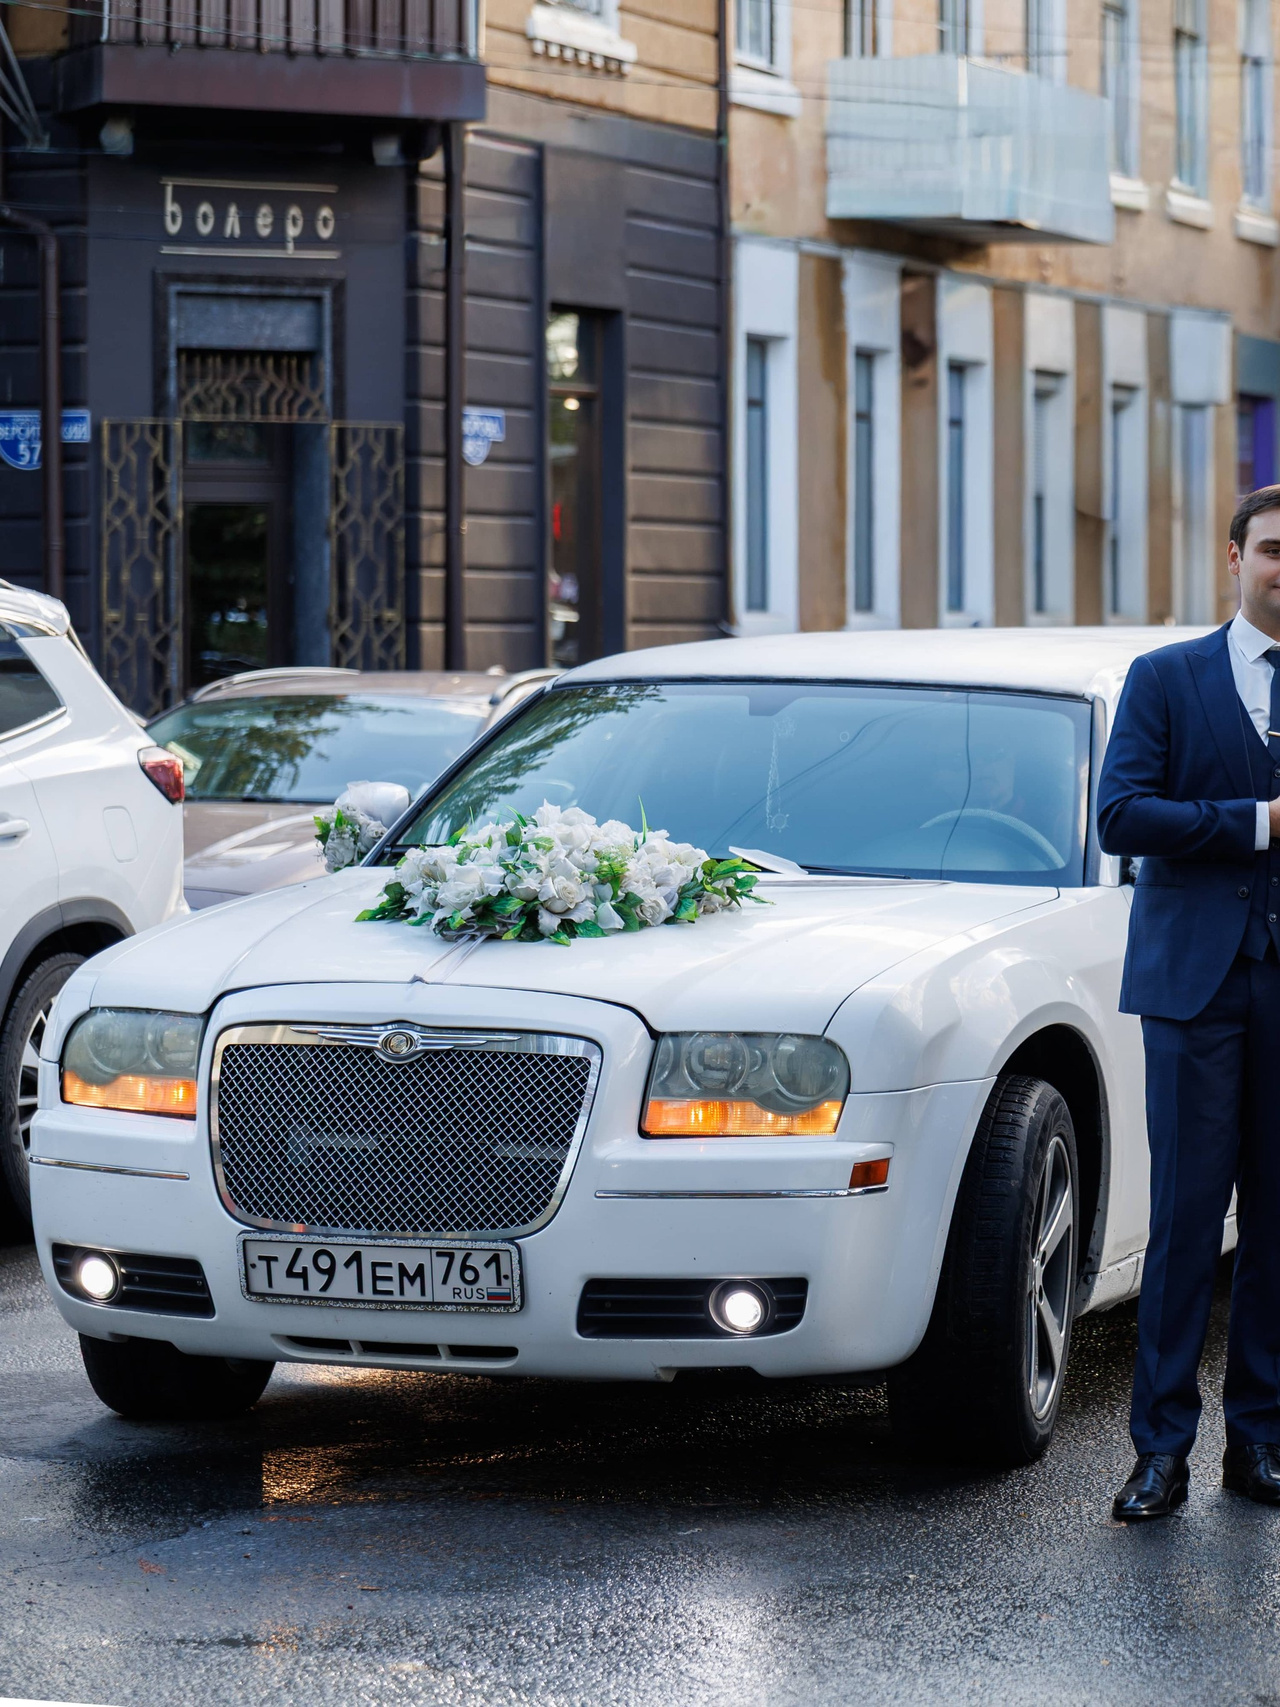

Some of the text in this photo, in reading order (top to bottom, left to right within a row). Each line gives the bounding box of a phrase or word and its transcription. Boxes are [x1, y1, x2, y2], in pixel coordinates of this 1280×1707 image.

[19, 444, 41, 465] 57
[435, 1251, 502, 1287] 761
[452, 1287, 485, 1300] RUS
